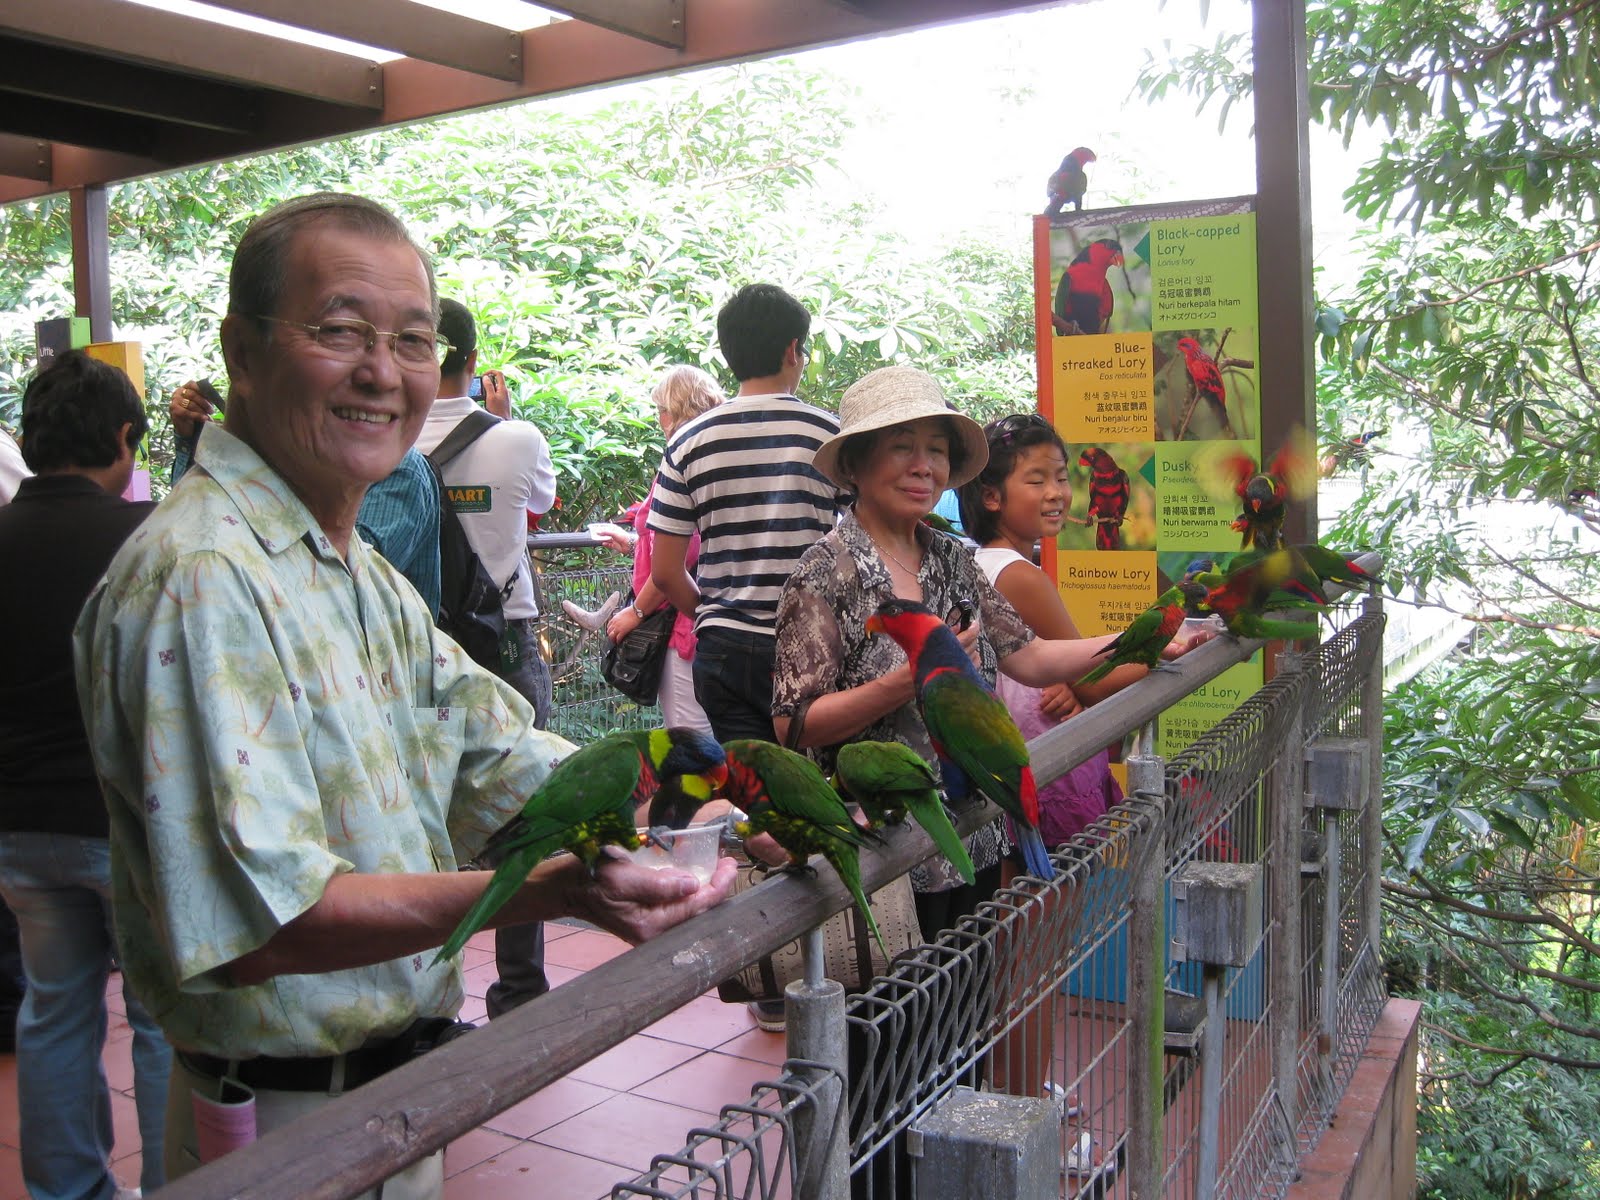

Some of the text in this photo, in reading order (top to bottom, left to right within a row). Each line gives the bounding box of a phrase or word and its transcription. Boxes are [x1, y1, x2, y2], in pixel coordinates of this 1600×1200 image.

[1157, 224, 1240, 240] Black-capped
[1157, 244, 1185, 256] Lory
[1158, 299, 1241, 310] Nuri berkepala hitam
[1114, 342, 1145, 353] Blue-
[1062, 357, 1146, 370] streaked Lory
[1085, 413, 1148, 424] Nuri berjalur biru
[1163, 518, 1179, 526] Nuri
[1181, 519, 1218, 527] berwarna
[1069, 566, 1151, 581] Rainbow Lory
[1061, 581, 1106, 591] Trichoglossus
[1100, 612, 1141, 622] 彩虹吸蜜
[1106, 624, 1122, 632] Nuri
[1212, 686, 1241, 701] Lory
[1166, 741, 1182, 749] Nuri
